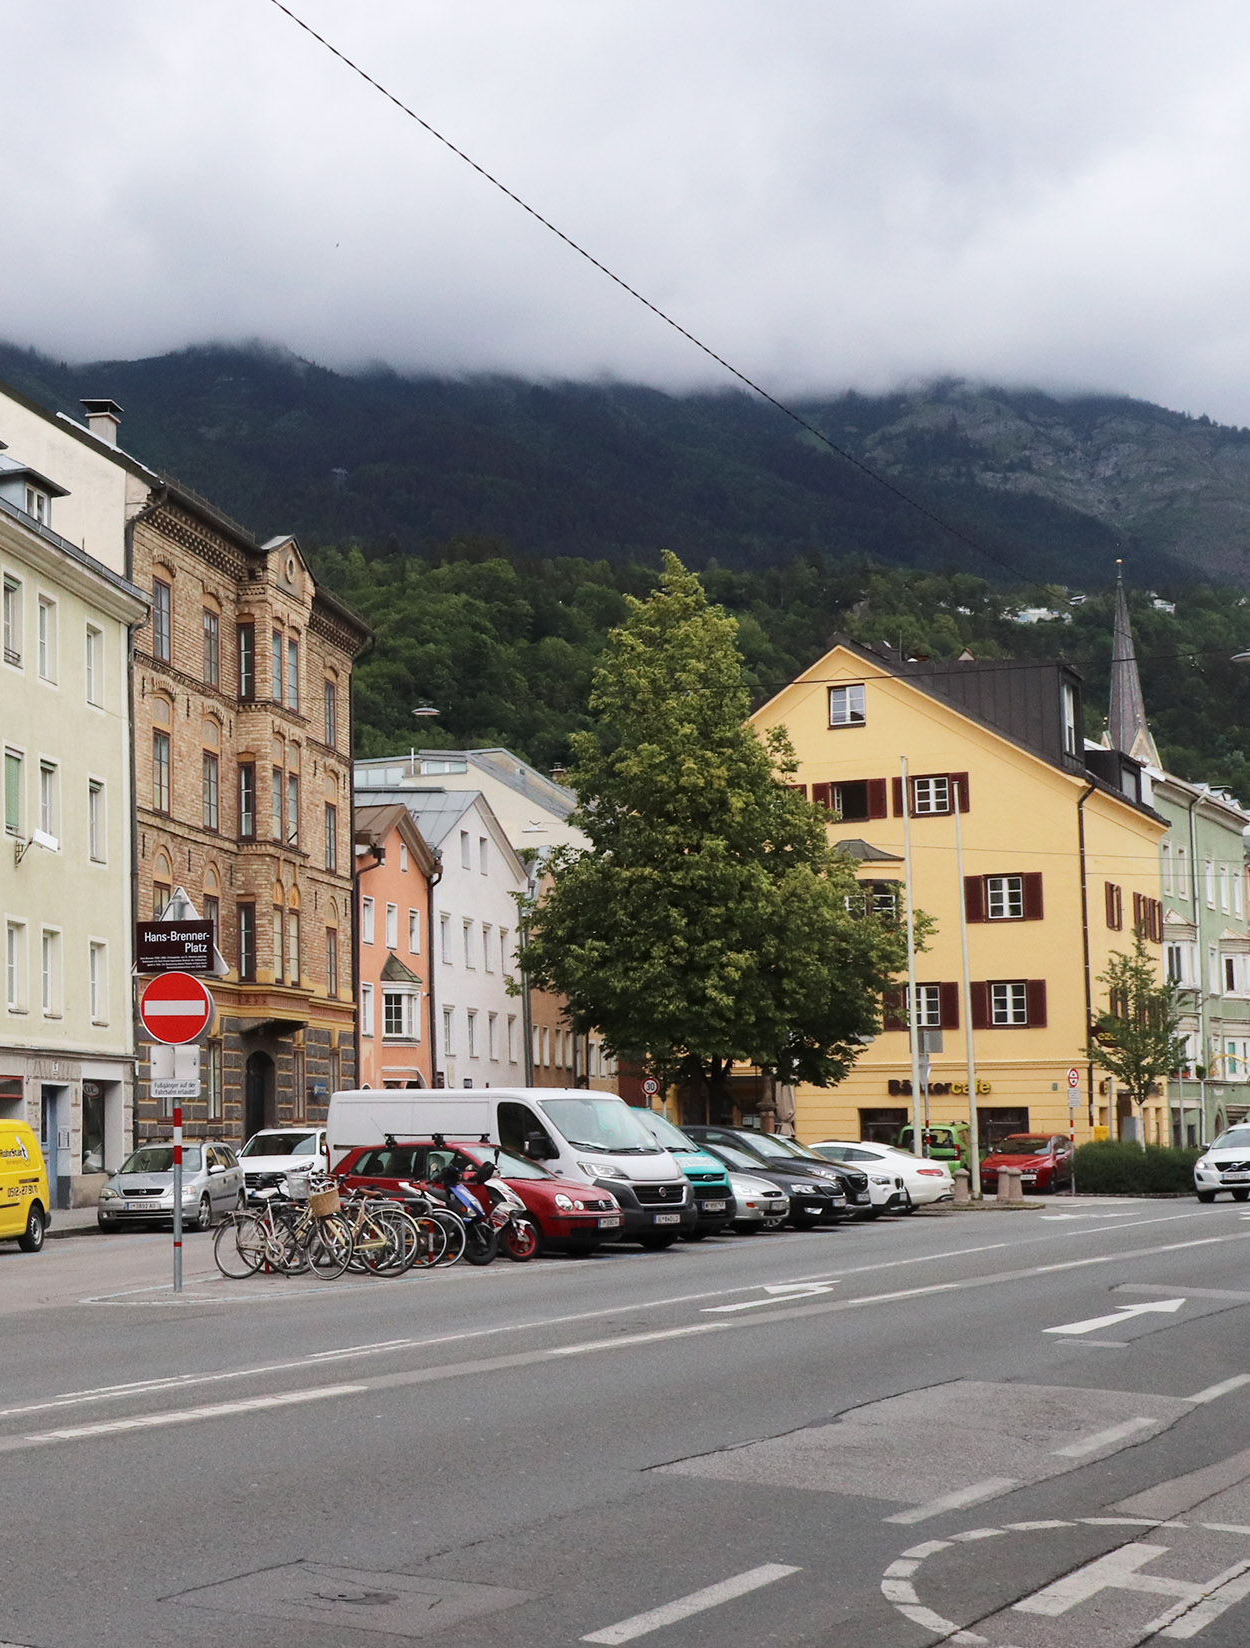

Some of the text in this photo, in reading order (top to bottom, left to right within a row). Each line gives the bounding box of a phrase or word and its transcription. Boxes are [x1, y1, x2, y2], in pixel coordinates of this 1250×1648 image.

[144, 931, 210, 942] Hans-Brenner-
[184, 942, 208, 953] Platz
[154, 1082, 178, 1090] Fußgänger
[645, 1082, 655, 1091] 30
